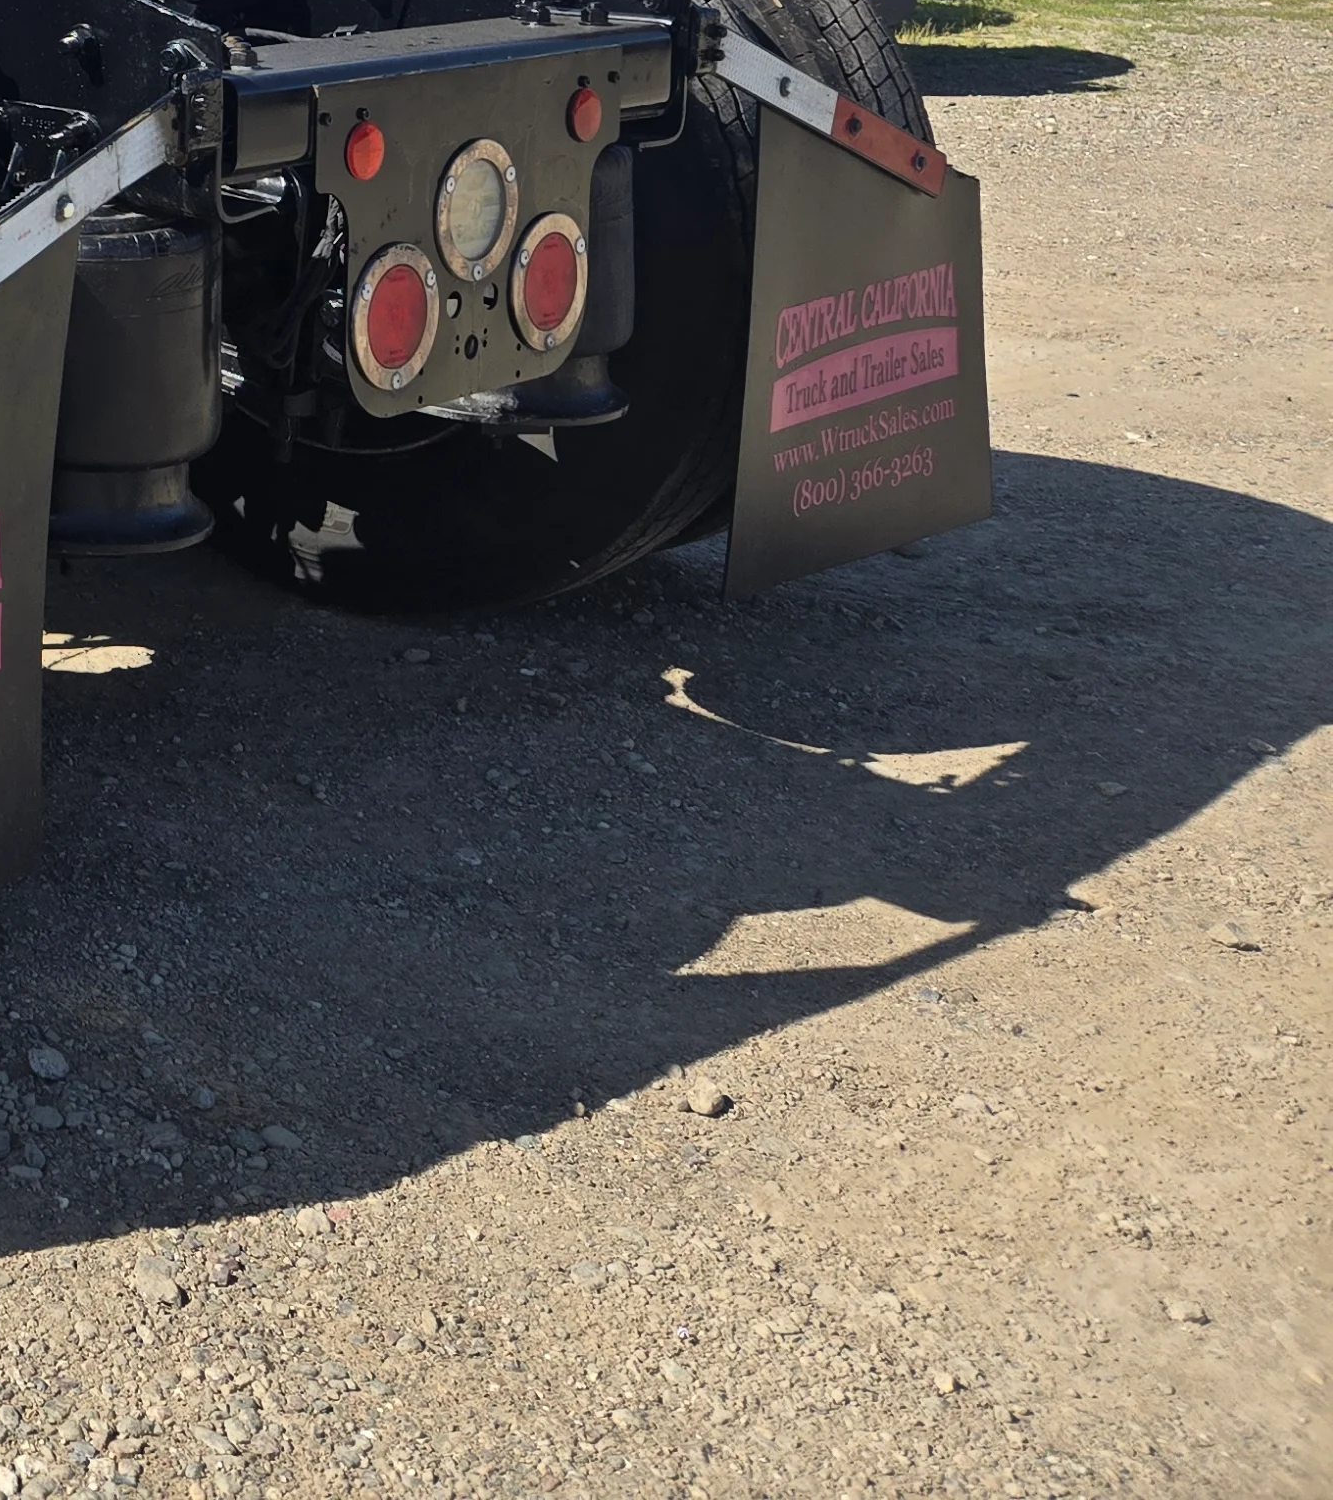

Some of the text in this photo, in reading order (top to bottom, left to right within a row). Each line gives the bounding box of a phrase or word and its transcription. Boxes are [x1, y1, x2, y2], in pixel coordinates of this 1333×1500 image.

[775, 261, 958, 368] CENTRAL CALIFORNIA
[785, 341, 945, 415] Truck and Trailer Sales
[793, 446, 934, 518] (800) 366-3263
